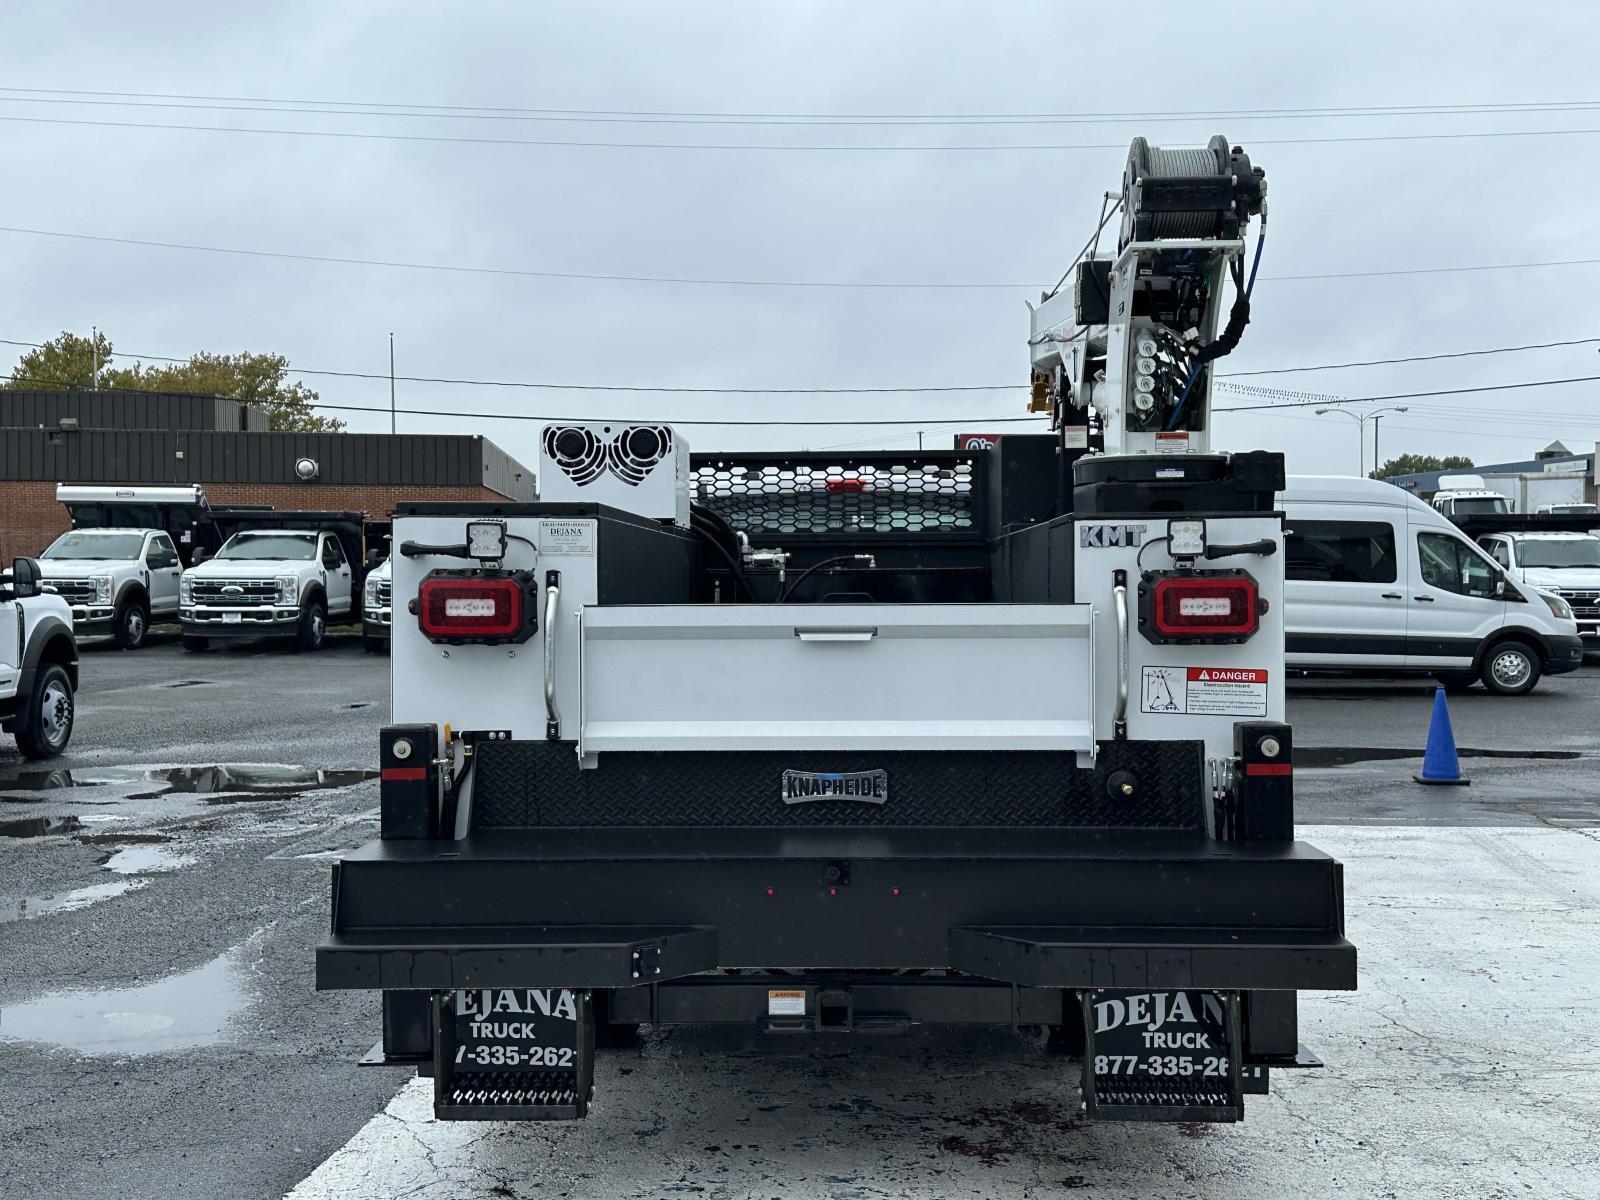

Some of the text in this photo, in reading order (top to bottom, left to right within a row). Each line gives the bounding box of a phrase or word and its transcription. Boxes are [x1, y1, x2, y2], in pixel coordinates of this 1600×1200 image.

[550, 528, 583, 536] DEJANA
[1080, 524, 1147, 547] KMT
[1212, 671, 1256, 681] DANGER
[787, 775, 884, 798] KNAPHEIDE
[469, 1022, 536, 1039] TRUCK
[1142, 1032, 1211, 1049] TRUCK
